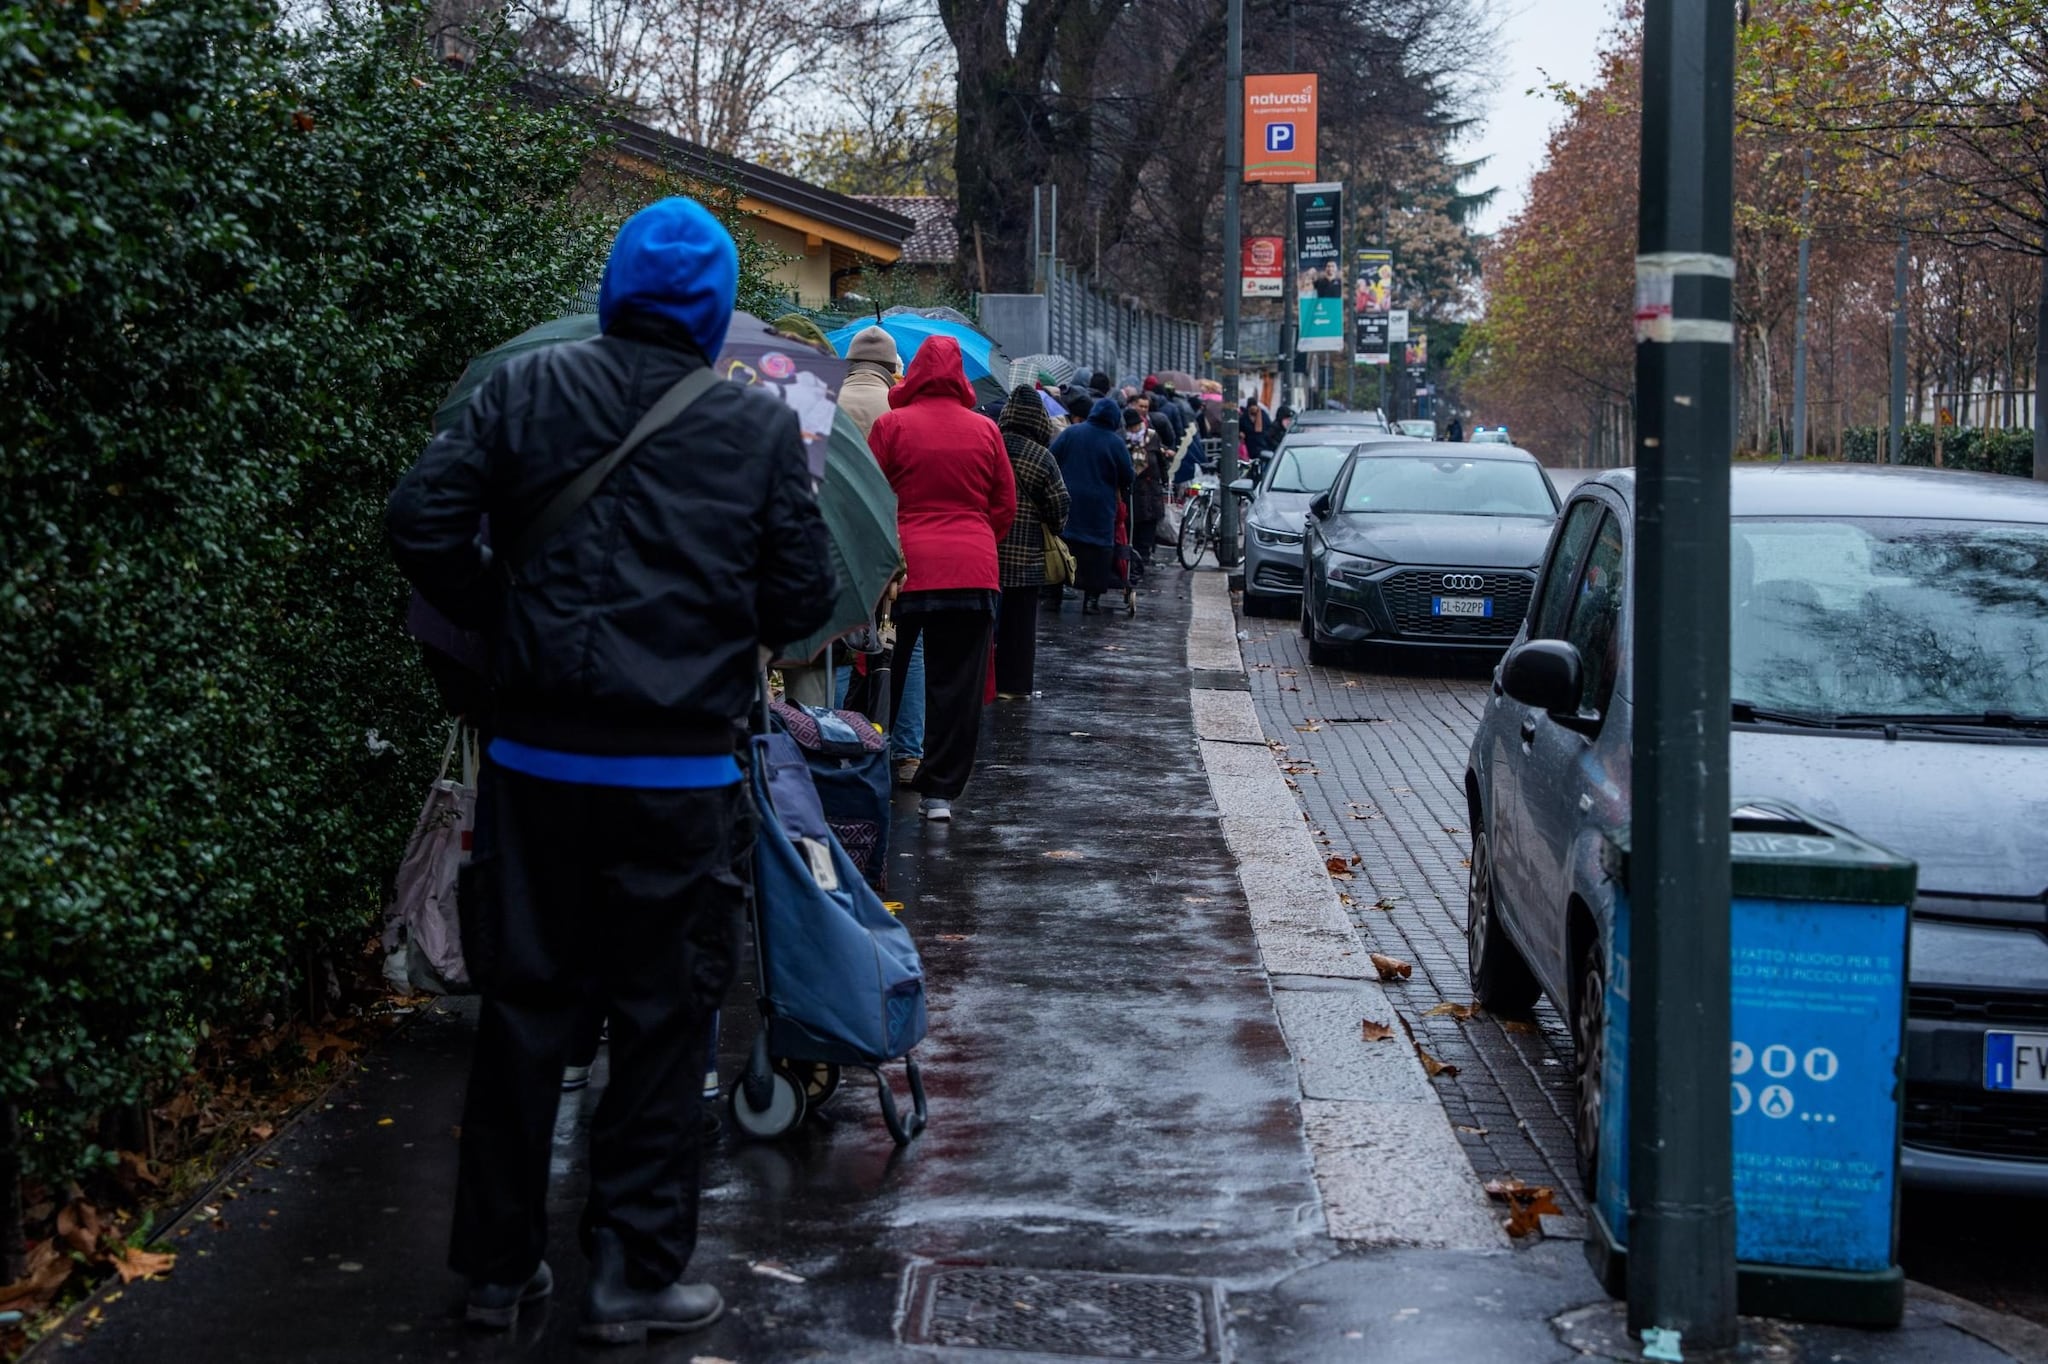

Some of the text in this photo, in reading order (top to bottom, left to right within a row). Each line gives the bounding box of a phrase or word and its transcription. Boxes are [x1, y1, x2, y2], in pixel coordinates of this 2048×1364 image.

[1271, 125, 1290, 150] P
[1740, 948, 1787, 963] FATTO
[1788, 951, 1844, 967] NUOVO
[1847, 954, 1873, 969] PER
